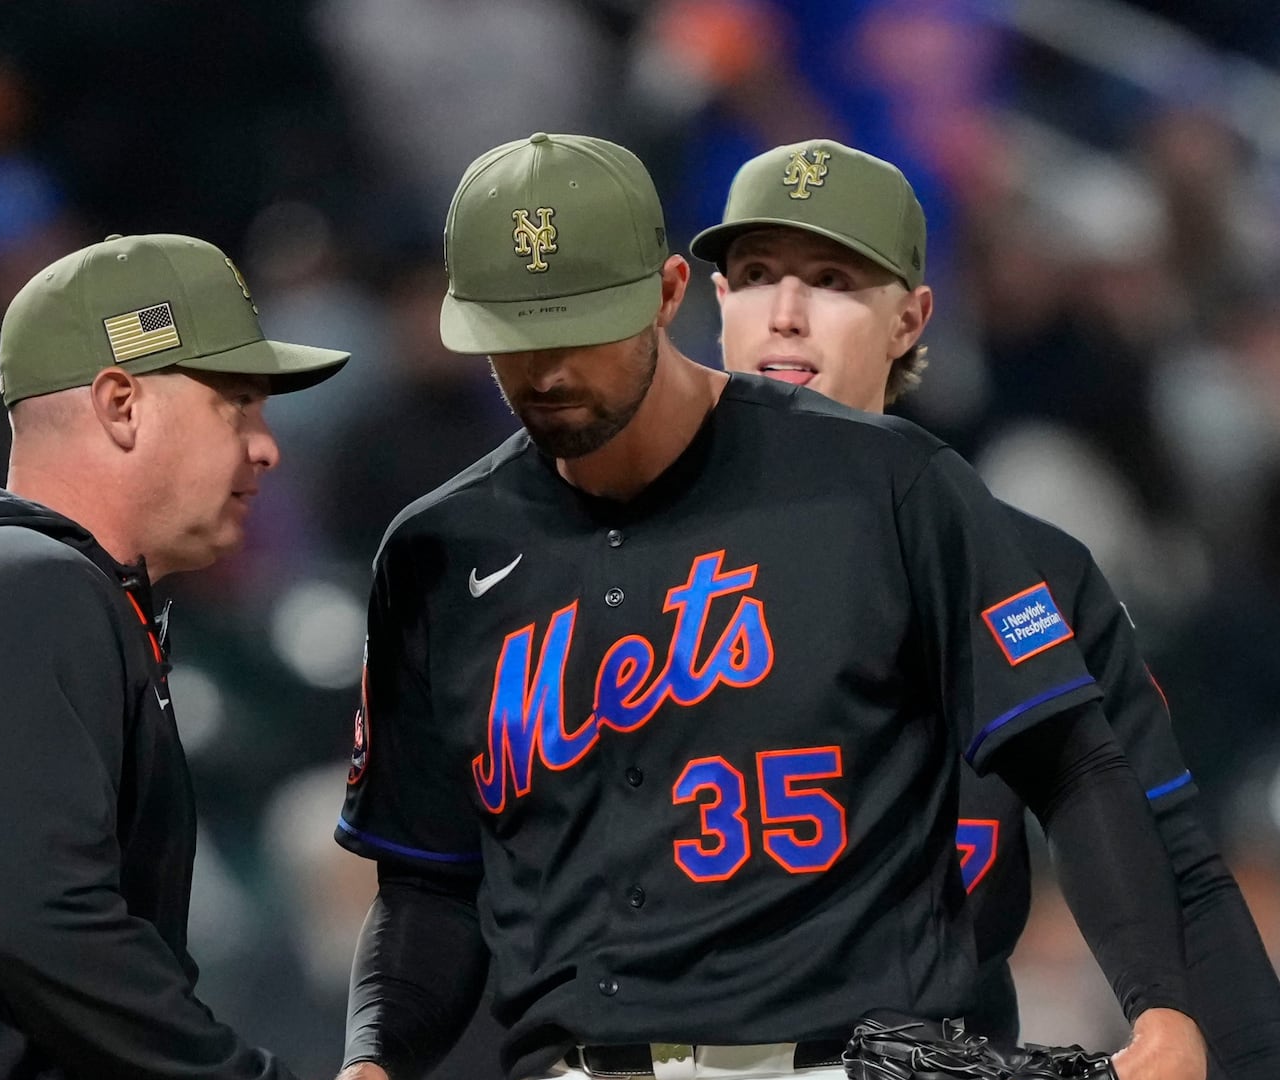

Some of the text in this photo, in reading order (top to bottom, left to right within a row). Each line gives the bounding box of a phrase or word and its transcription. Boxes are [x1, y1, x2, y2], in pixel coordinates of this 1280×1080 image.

[1006, 601, 1046, 628] NewYork-
[1014, 612, 1062, 640] Presbyterian
[471, 549, 775, 815] Mets
[672, 745, 848, 883] 35
